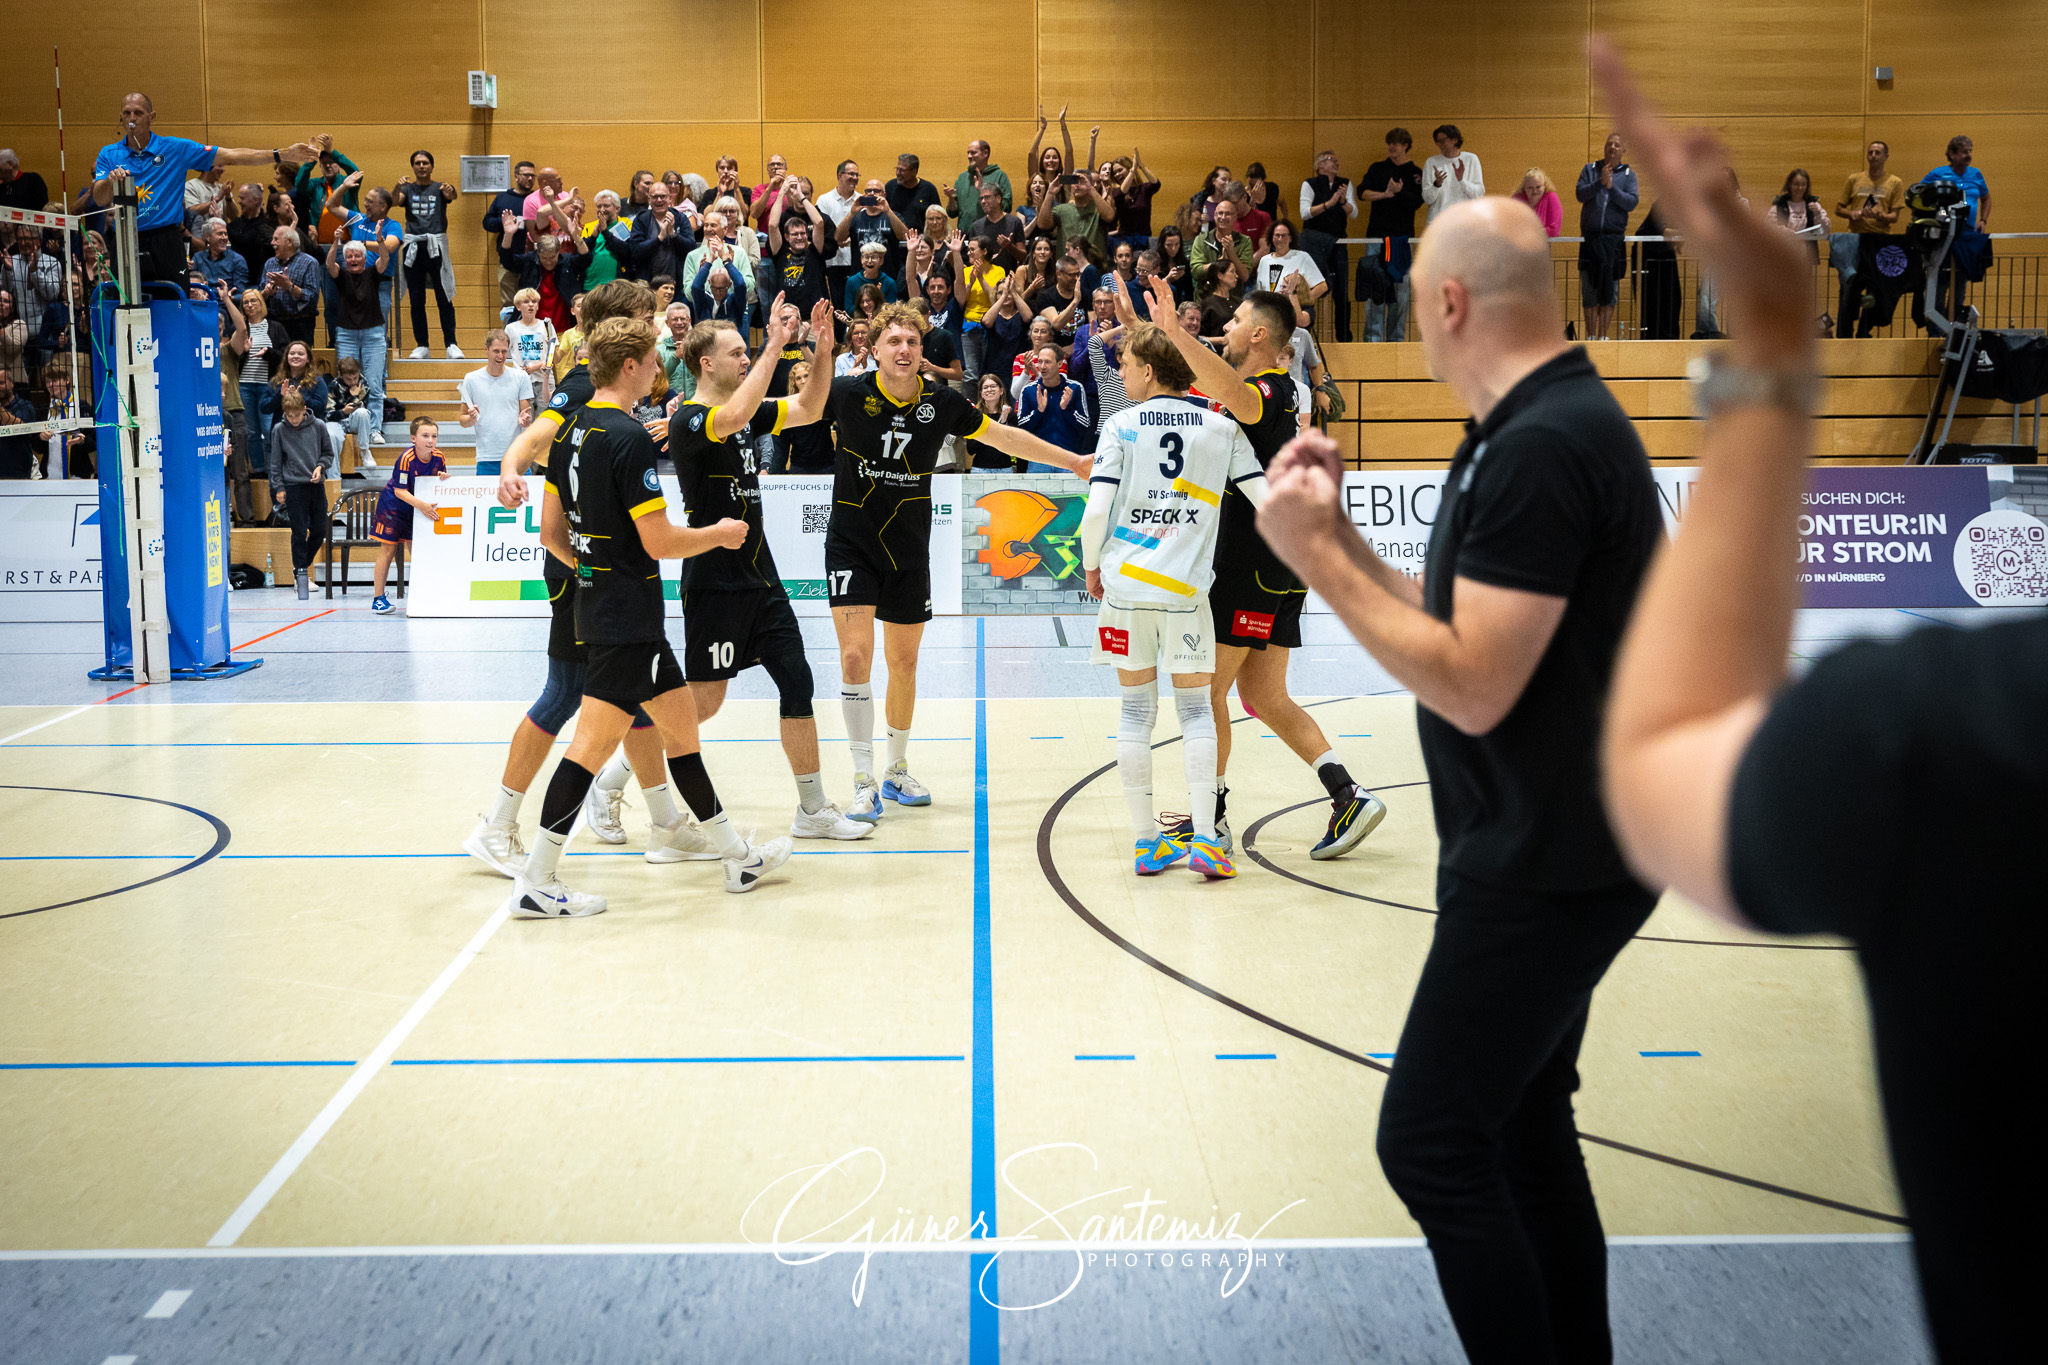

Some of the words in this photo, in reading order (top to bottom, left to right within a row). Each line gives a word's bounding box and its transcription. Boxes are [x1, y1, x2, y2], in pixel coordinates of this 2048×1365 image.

[205, 403, 220, 416] bauen,
[1140, 411, 1203, 426] DOBBERTIN
[196, 426, 205, 437] was
[206, 422, 222, 436] andere
[206, 442, 222, 459] planen!
[881, 430, 913, 460] 17
[1159, 432, 1184, 479] 3
[568, 451, 579, 502] 6
[865, 468, 885, 478] Zapf
[885, 471, 920, 481] Daigfuss
[1148, 490, 1158, 499] SV
[1160, 489, 1188, 500] Schwaig
[1801, 493, 1861, 504] SUCHEN
[1866, 492, 1906, 504] DICH:
[1344, 485, 1445, 526] EBIC
[1131, 509, 1181, 524] SPECK
[1128, 526, 1180, 541] pumpen
[486, 543, 546, 562] Ideen
[1832, 541, 1932, 563] STROM
[829, 570, 852, 596] 17
[1814, 574, 1826, 582] IN
[1828, 571, 1886, 583] NÜRNBERG
[1247, 625, 1268, 634] Nürnberg
[1248, 620, 1271, 628] Sparkasse
[708, 641, 734, 669] 10
